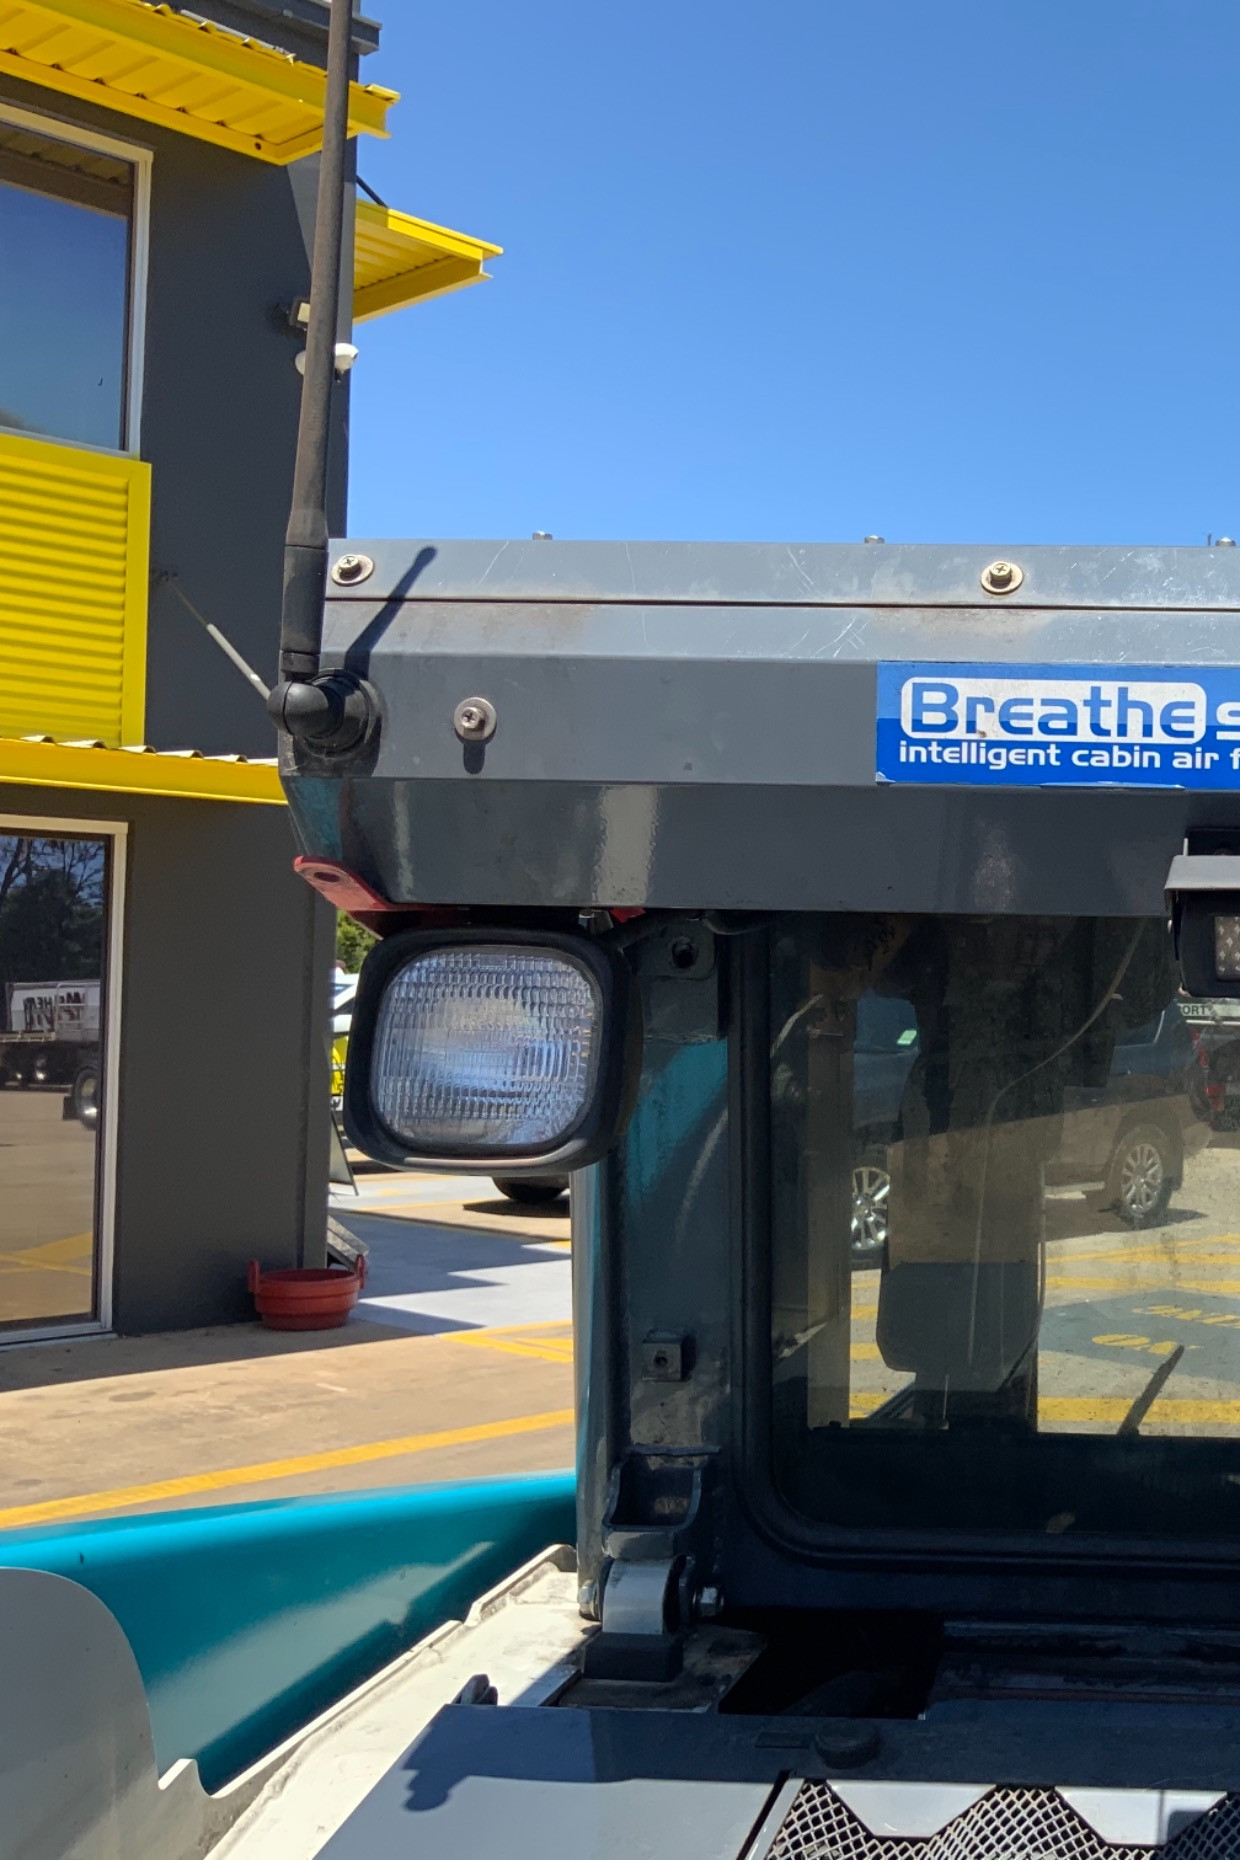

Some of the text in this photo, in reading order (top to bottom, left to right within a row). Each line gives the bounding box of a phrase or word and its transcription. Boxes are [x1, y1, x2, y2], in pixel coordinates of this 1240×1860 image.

[899, 741, 1060, 770] intelligent
[1072, 745, 1161, 769] cabin
[1172, 747, 1219, 769] air
[1181, 1005, 1208, 1015] ORT
